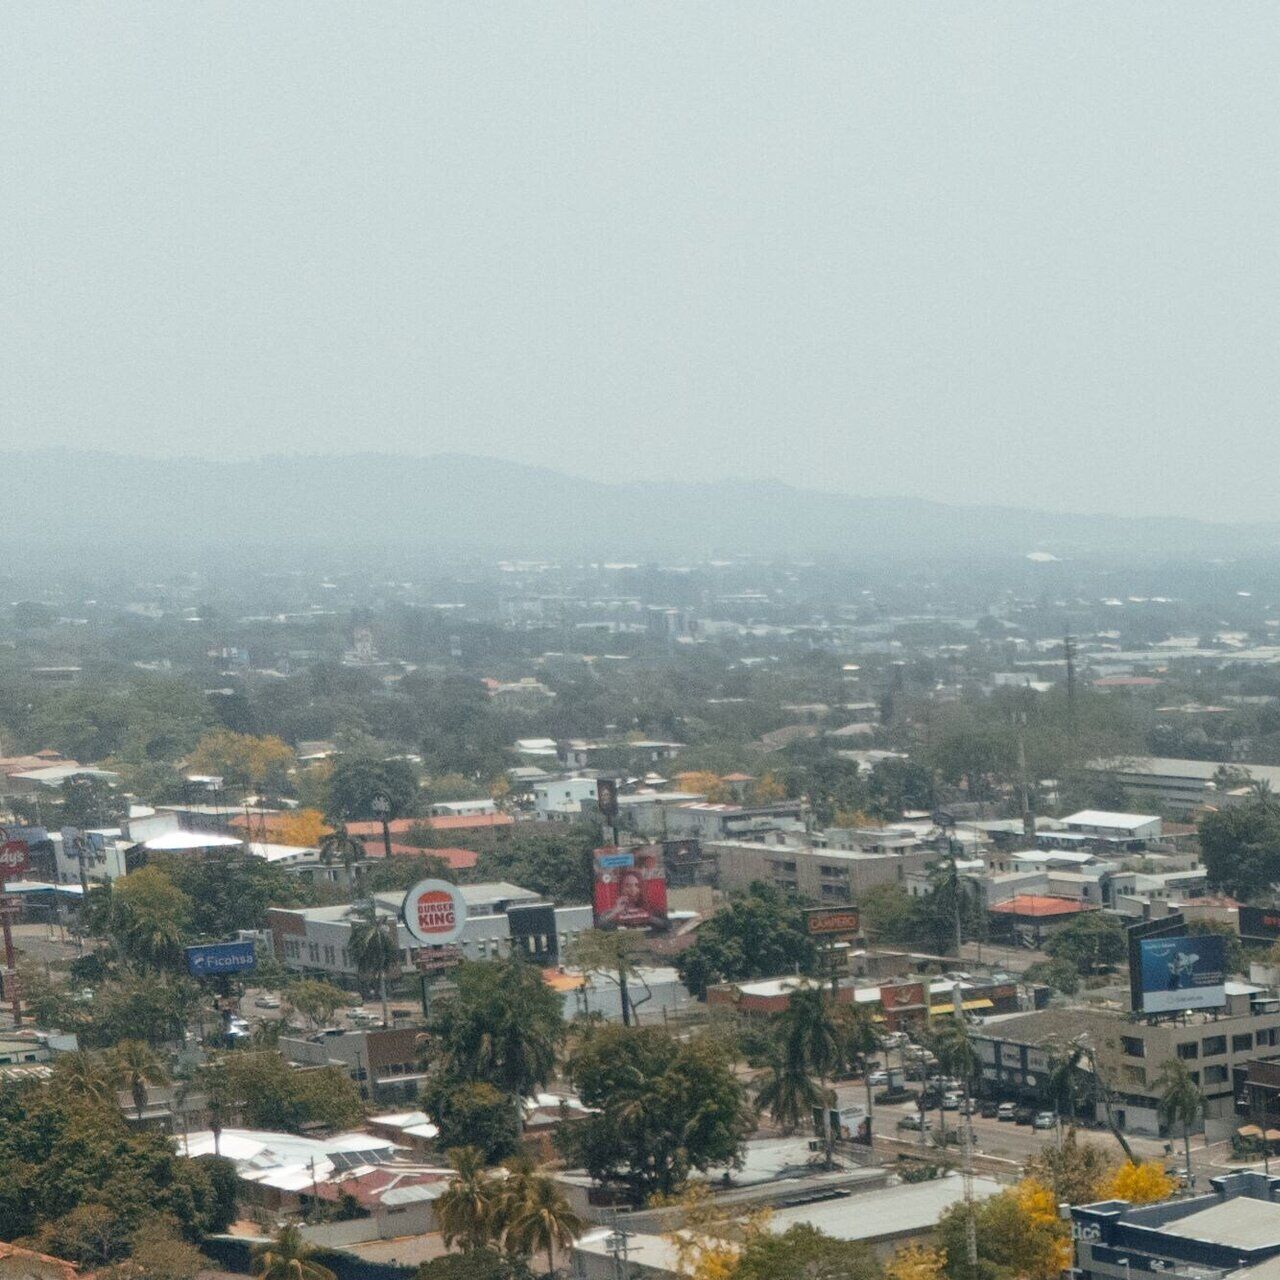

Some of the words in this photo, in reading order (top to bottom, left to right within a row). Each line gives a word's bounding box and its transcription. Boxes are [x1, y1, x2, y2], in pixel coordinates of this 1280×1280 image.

[418, 903, 454, 914] BURGER
[418, 911, 456, 927] KING
[206, 955, 253, 968] Ficohsa
